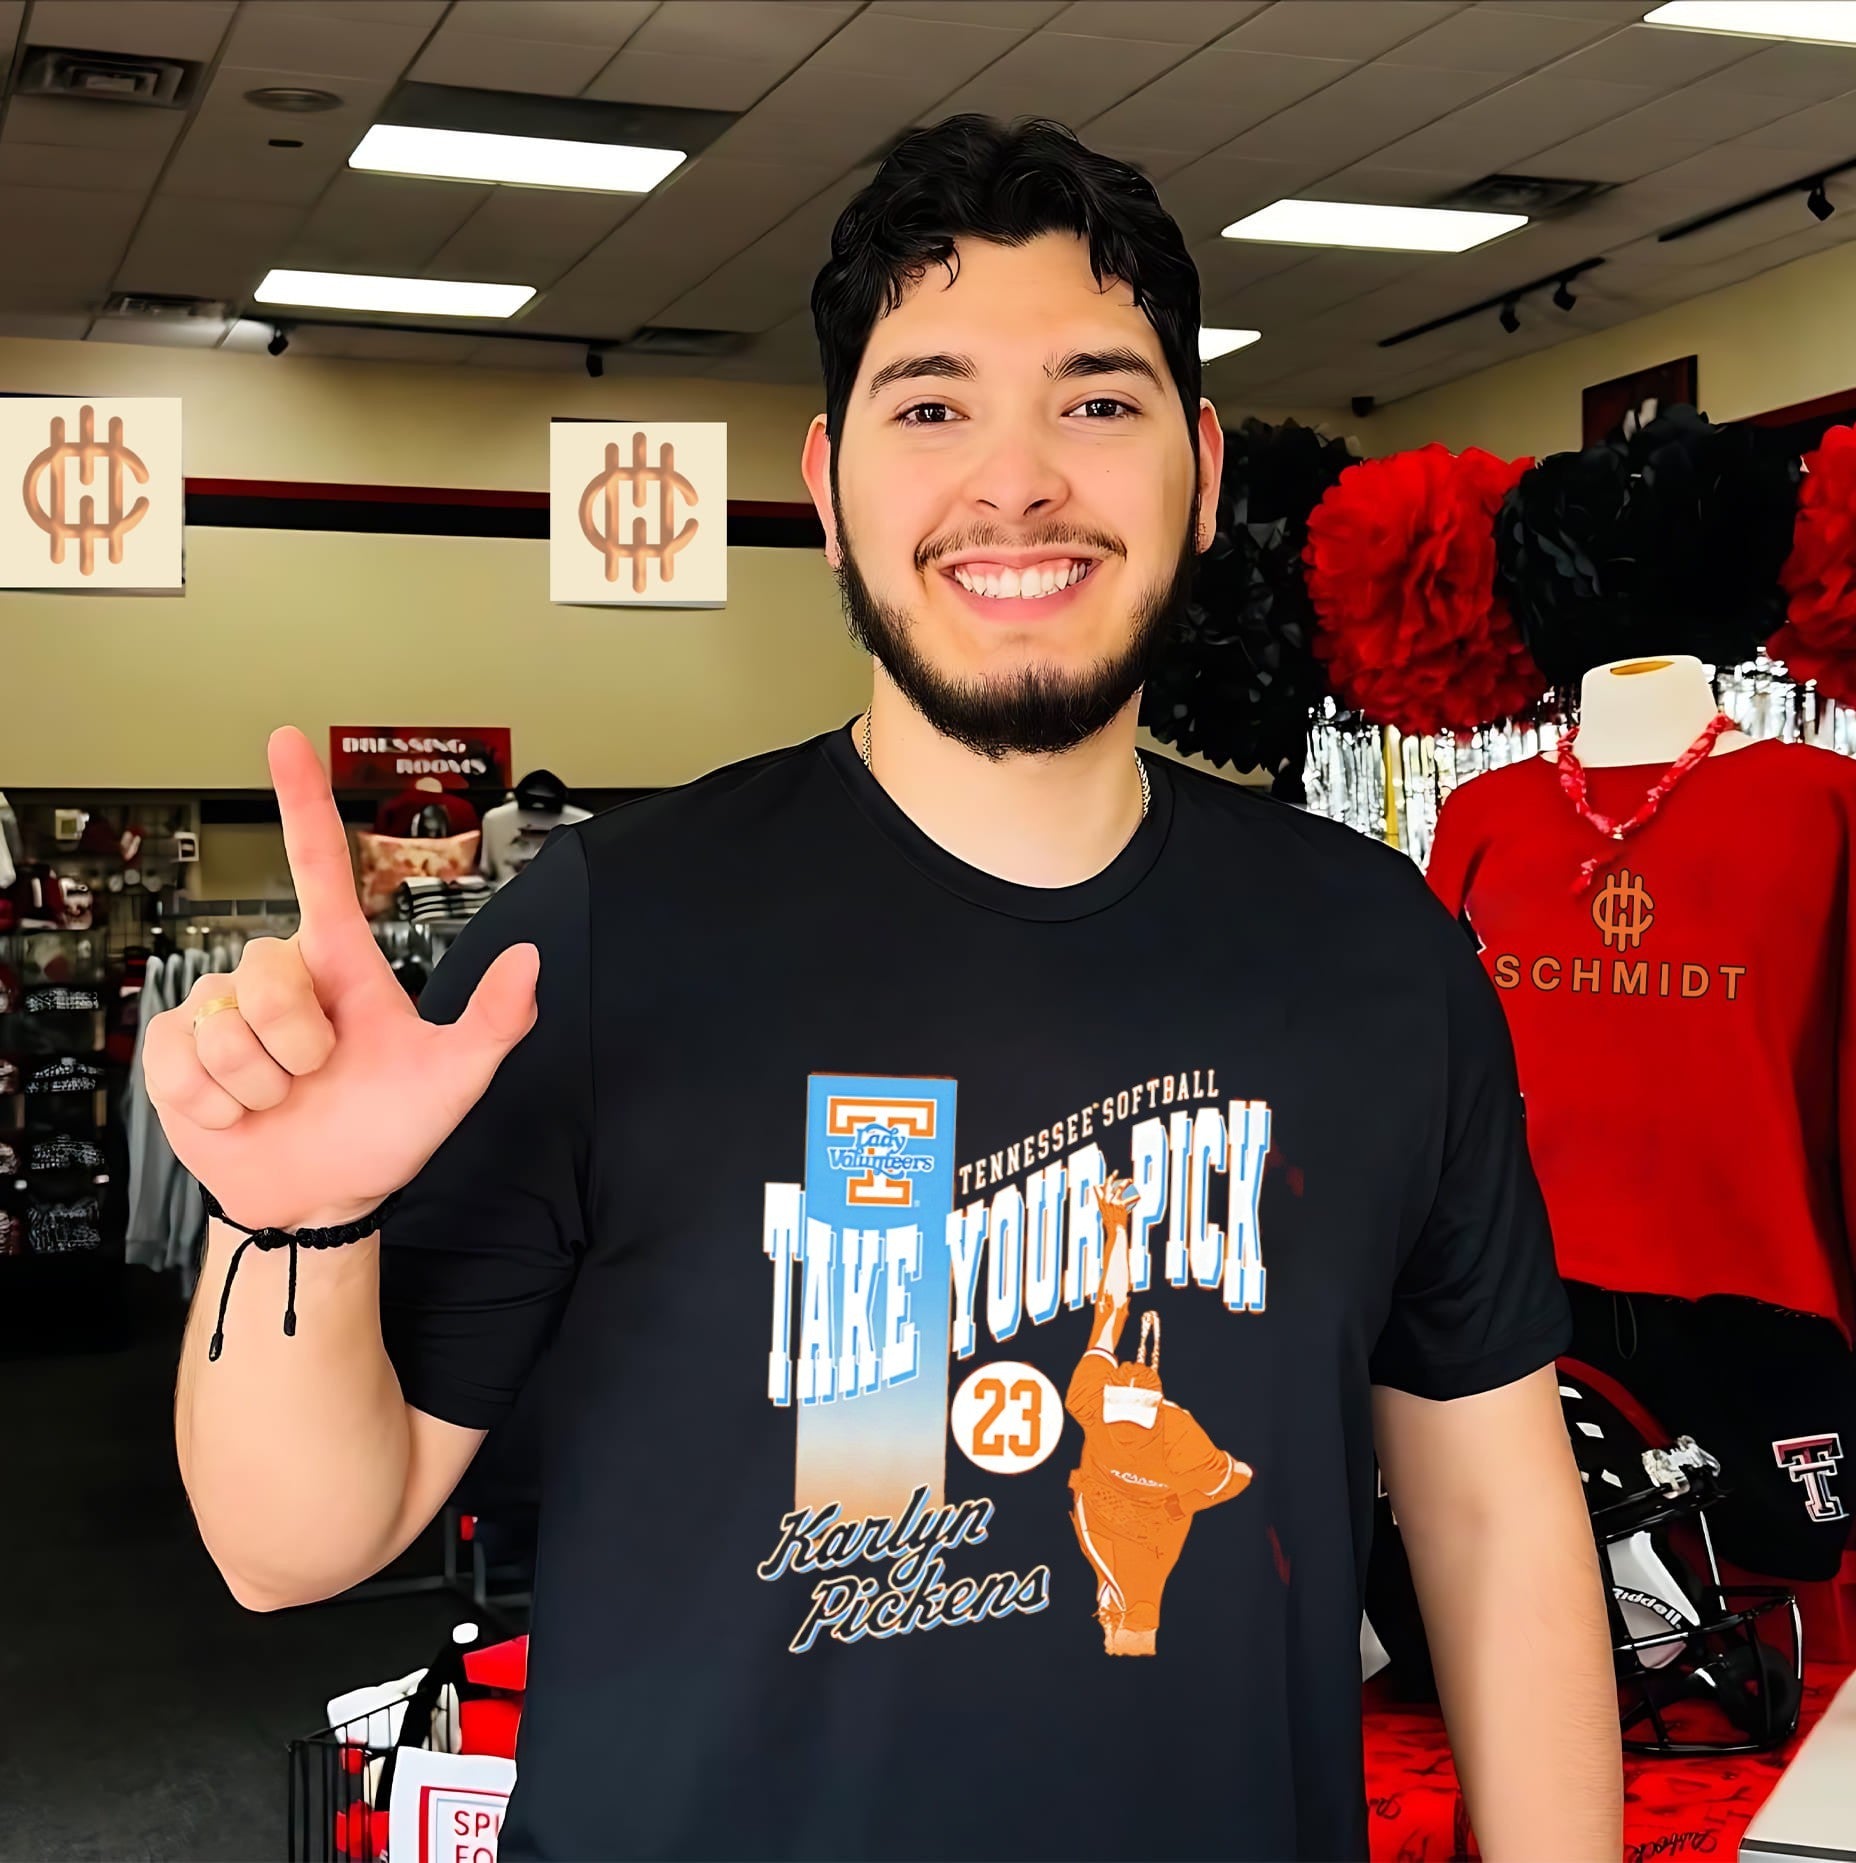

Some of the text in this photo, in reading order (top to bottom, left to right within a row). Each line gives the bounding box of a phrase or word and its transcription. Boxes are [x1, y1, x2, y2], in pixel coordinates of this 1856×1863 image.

[342, 737, 467, 755] DRESSING
[396, 758, 487, 776] ROOMS
[1494, 953, 1747, 1001] SCHMIDT
[854, 1123, 907, 1155] Lady
[958, 1068, 1220, 1195] TENNESSEE SOFTBALL
[827, 1146, 935, 1181] Volunteers
[763, 1100, 1271, 1407] TAKE YOUR PICK
[973, 1378, 1043, 1457] 23
[757, 1483, 996, 1591] Karlyn
[789, 1557, 1050, 1654] Pickens
